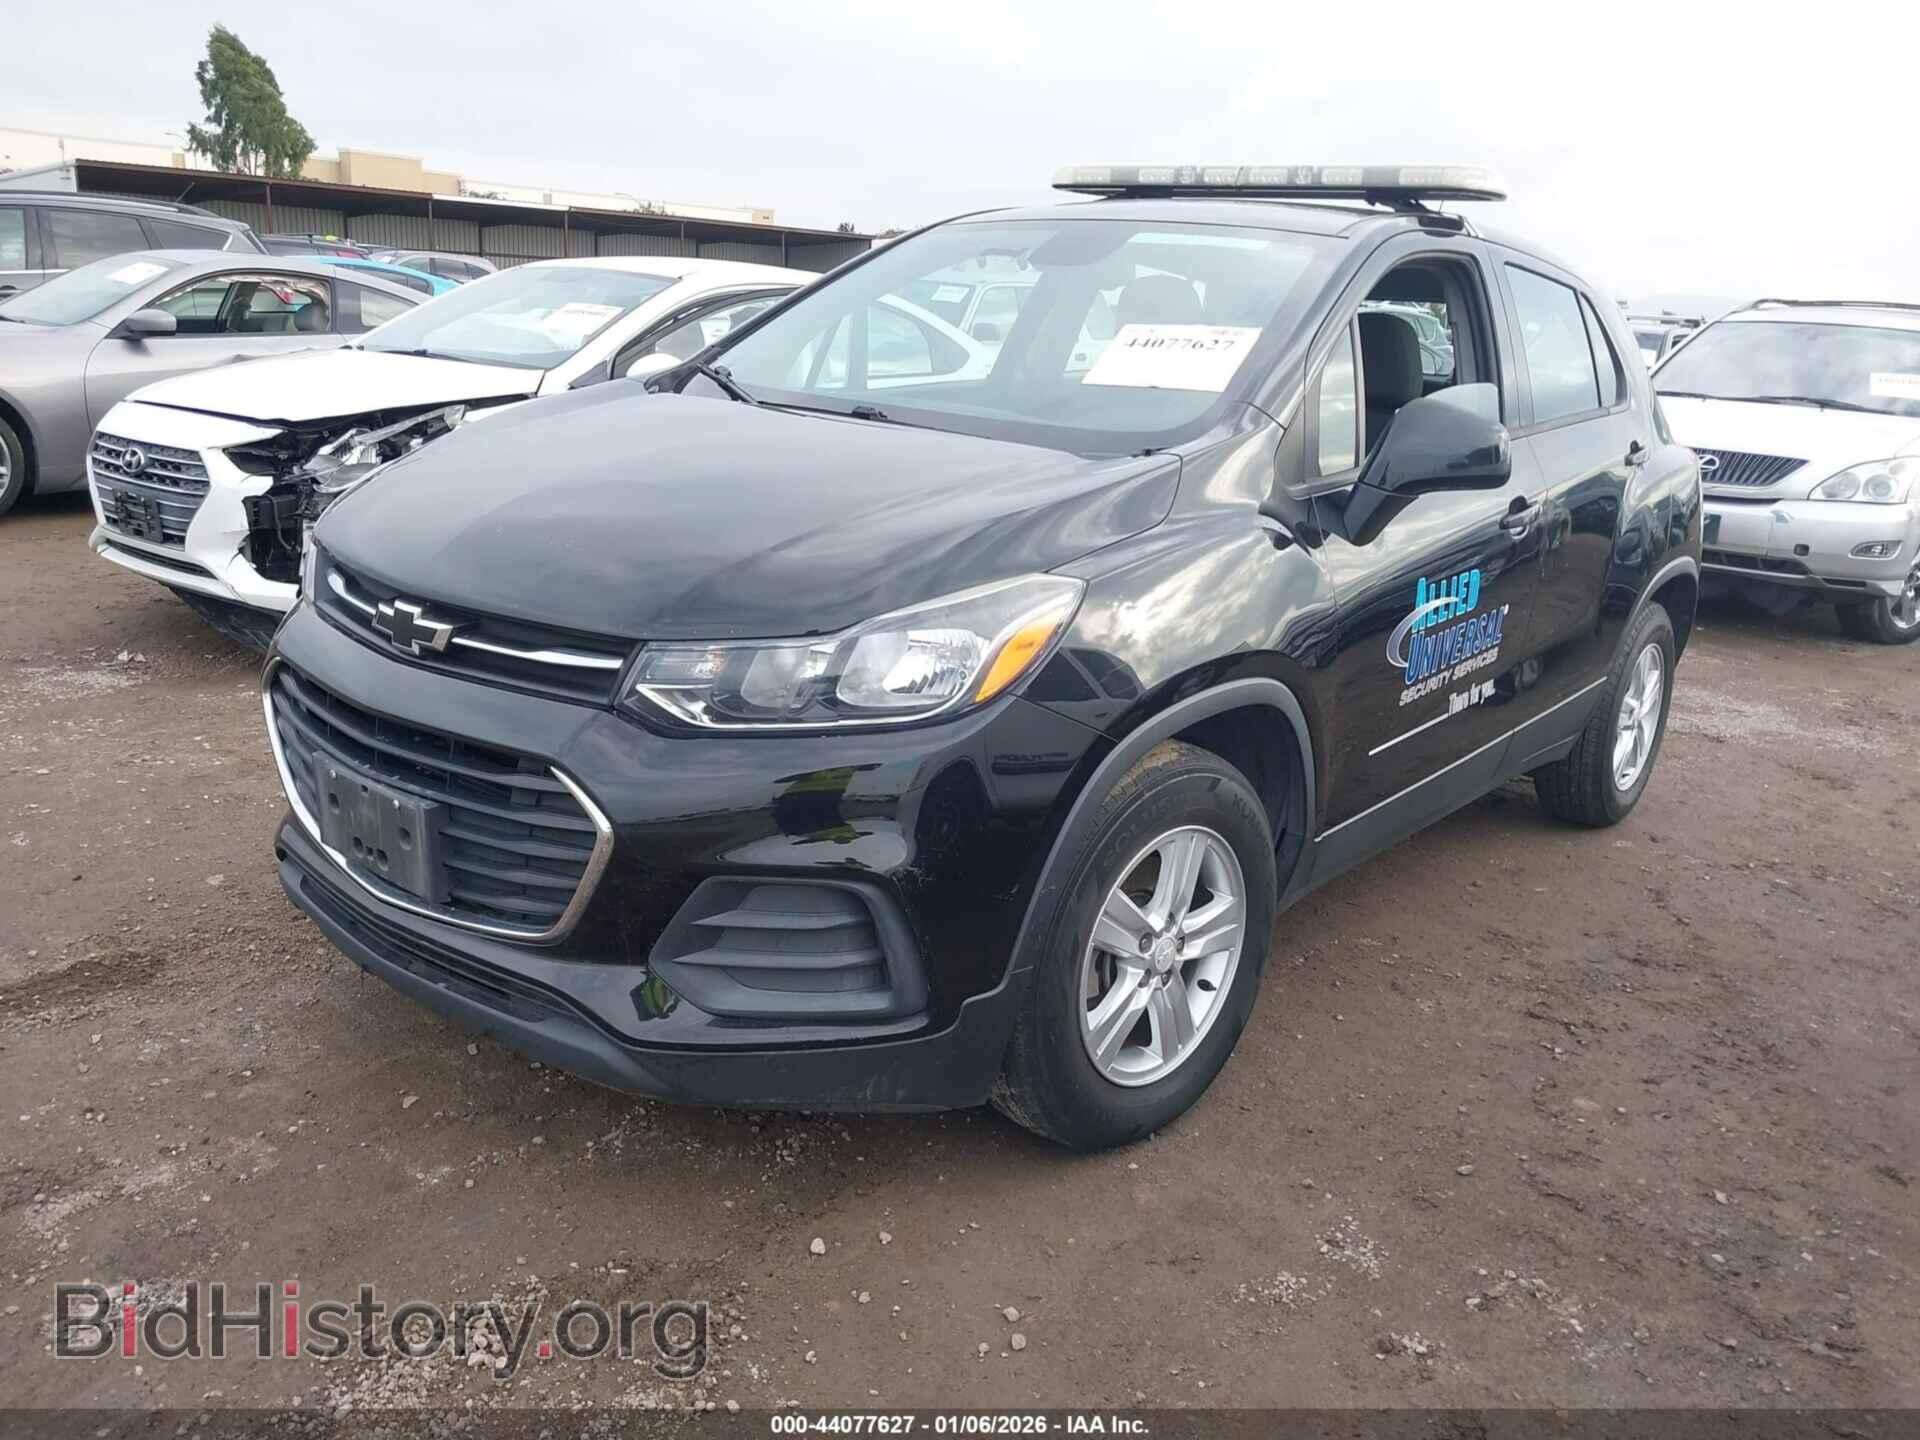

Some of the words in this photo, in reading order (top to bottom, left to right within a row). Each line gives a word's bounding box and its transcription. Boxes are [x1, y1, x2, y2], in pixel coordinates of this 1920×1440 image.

[1124, 337, 1236, 350] 44077627
[1411, 568, 1480, 633] ALLIED
[1405, 608, 1505, 685] UNIVERSAL
[1399, 668, 1453, 706] SECURITY
[1452, 647, 1499, 681] SERVICES
[1448, 690, 1470, 717] There
